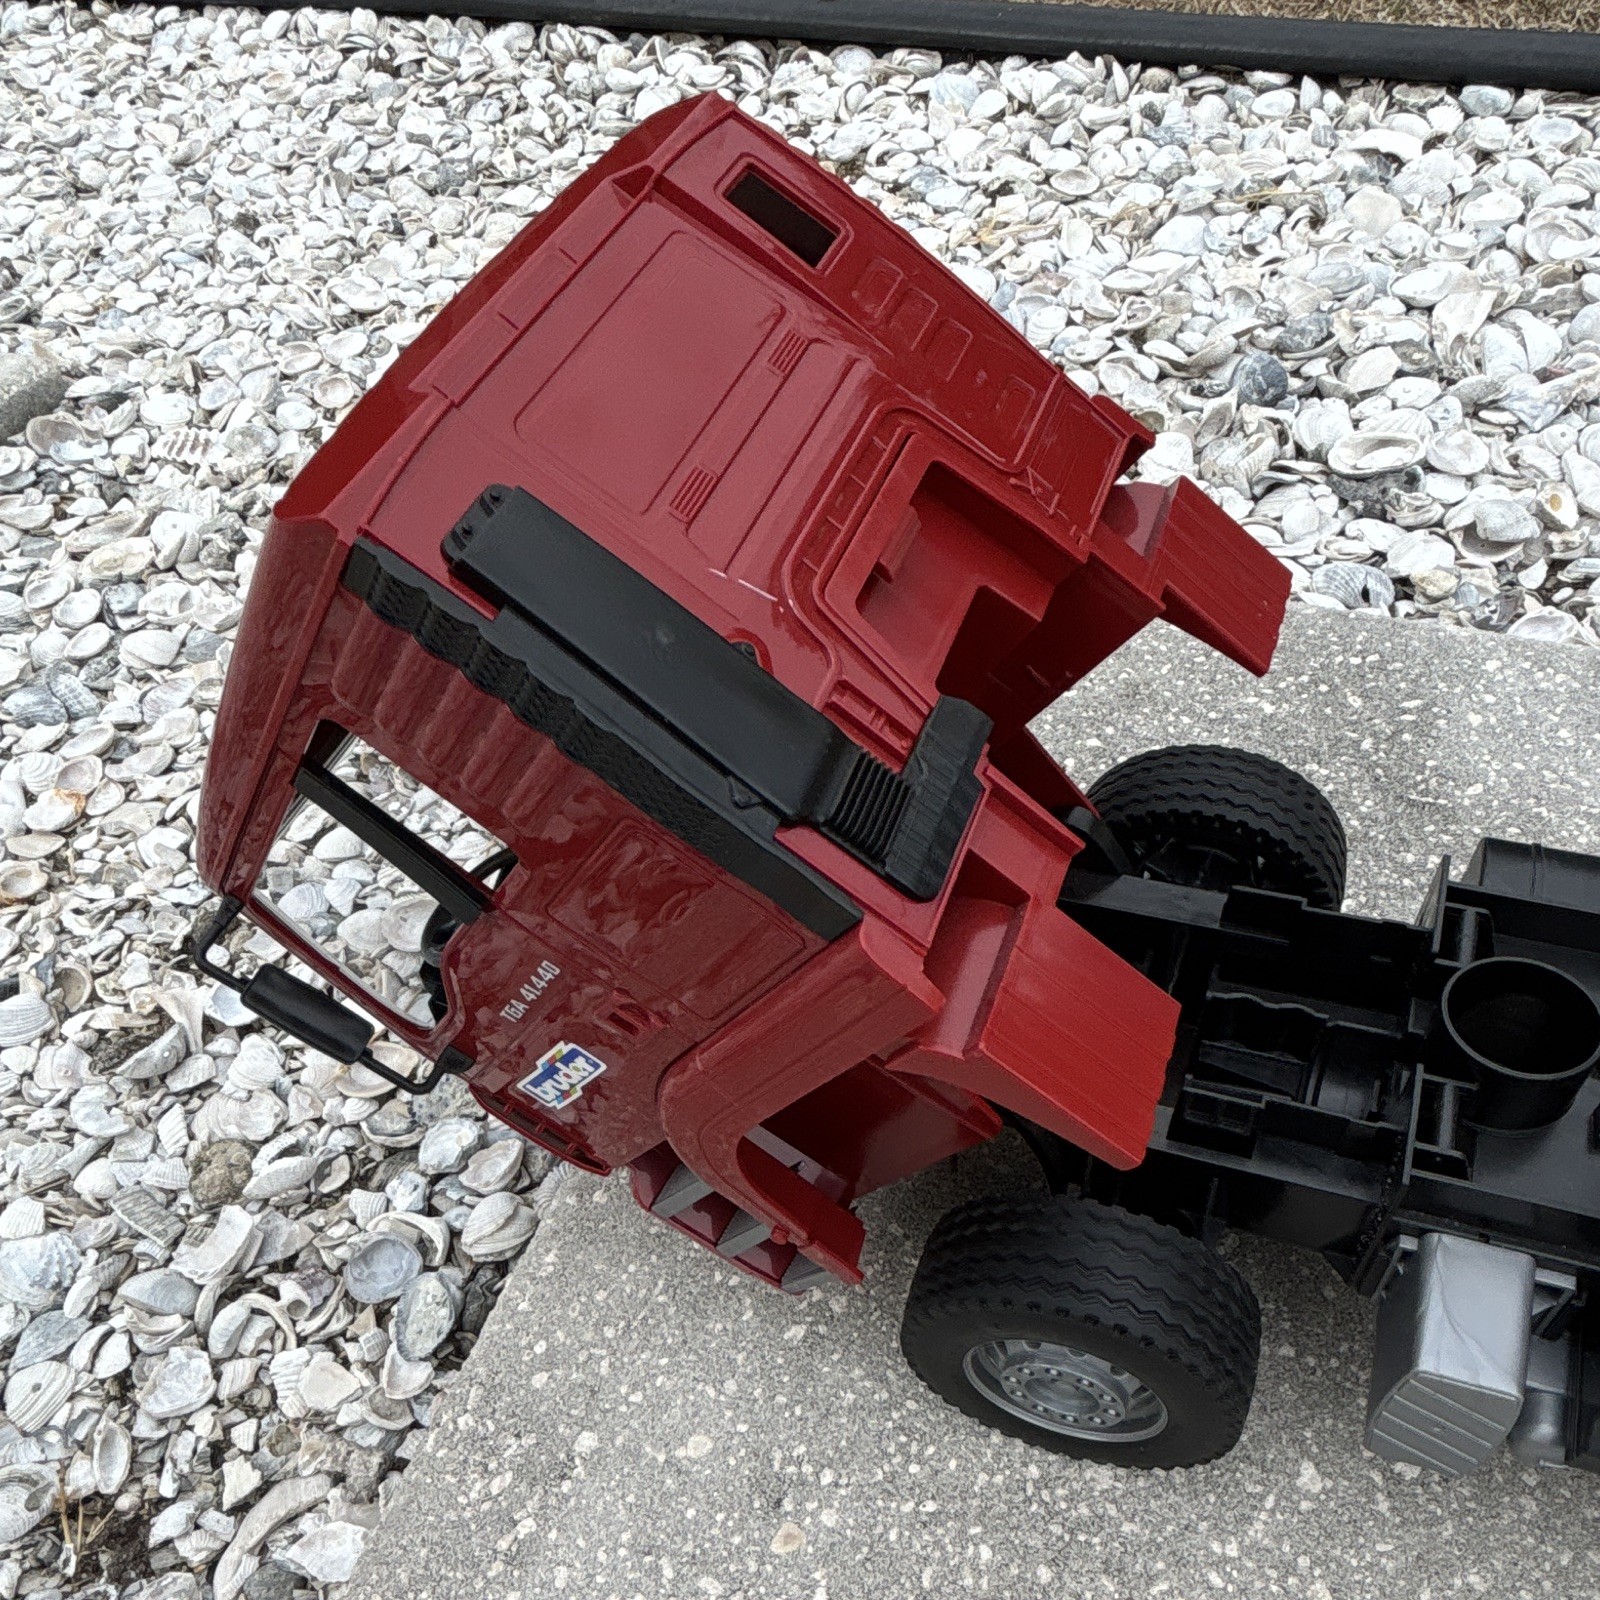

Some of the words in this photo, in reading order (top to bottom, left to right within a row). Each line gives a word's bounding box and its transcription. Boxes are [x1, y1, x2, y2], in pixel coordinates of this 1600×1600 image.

[499, 999, 529, 1022] TGA
[520, 960, 560, 1001] 41.440
[525, 1055, 595, 1102] bruder
